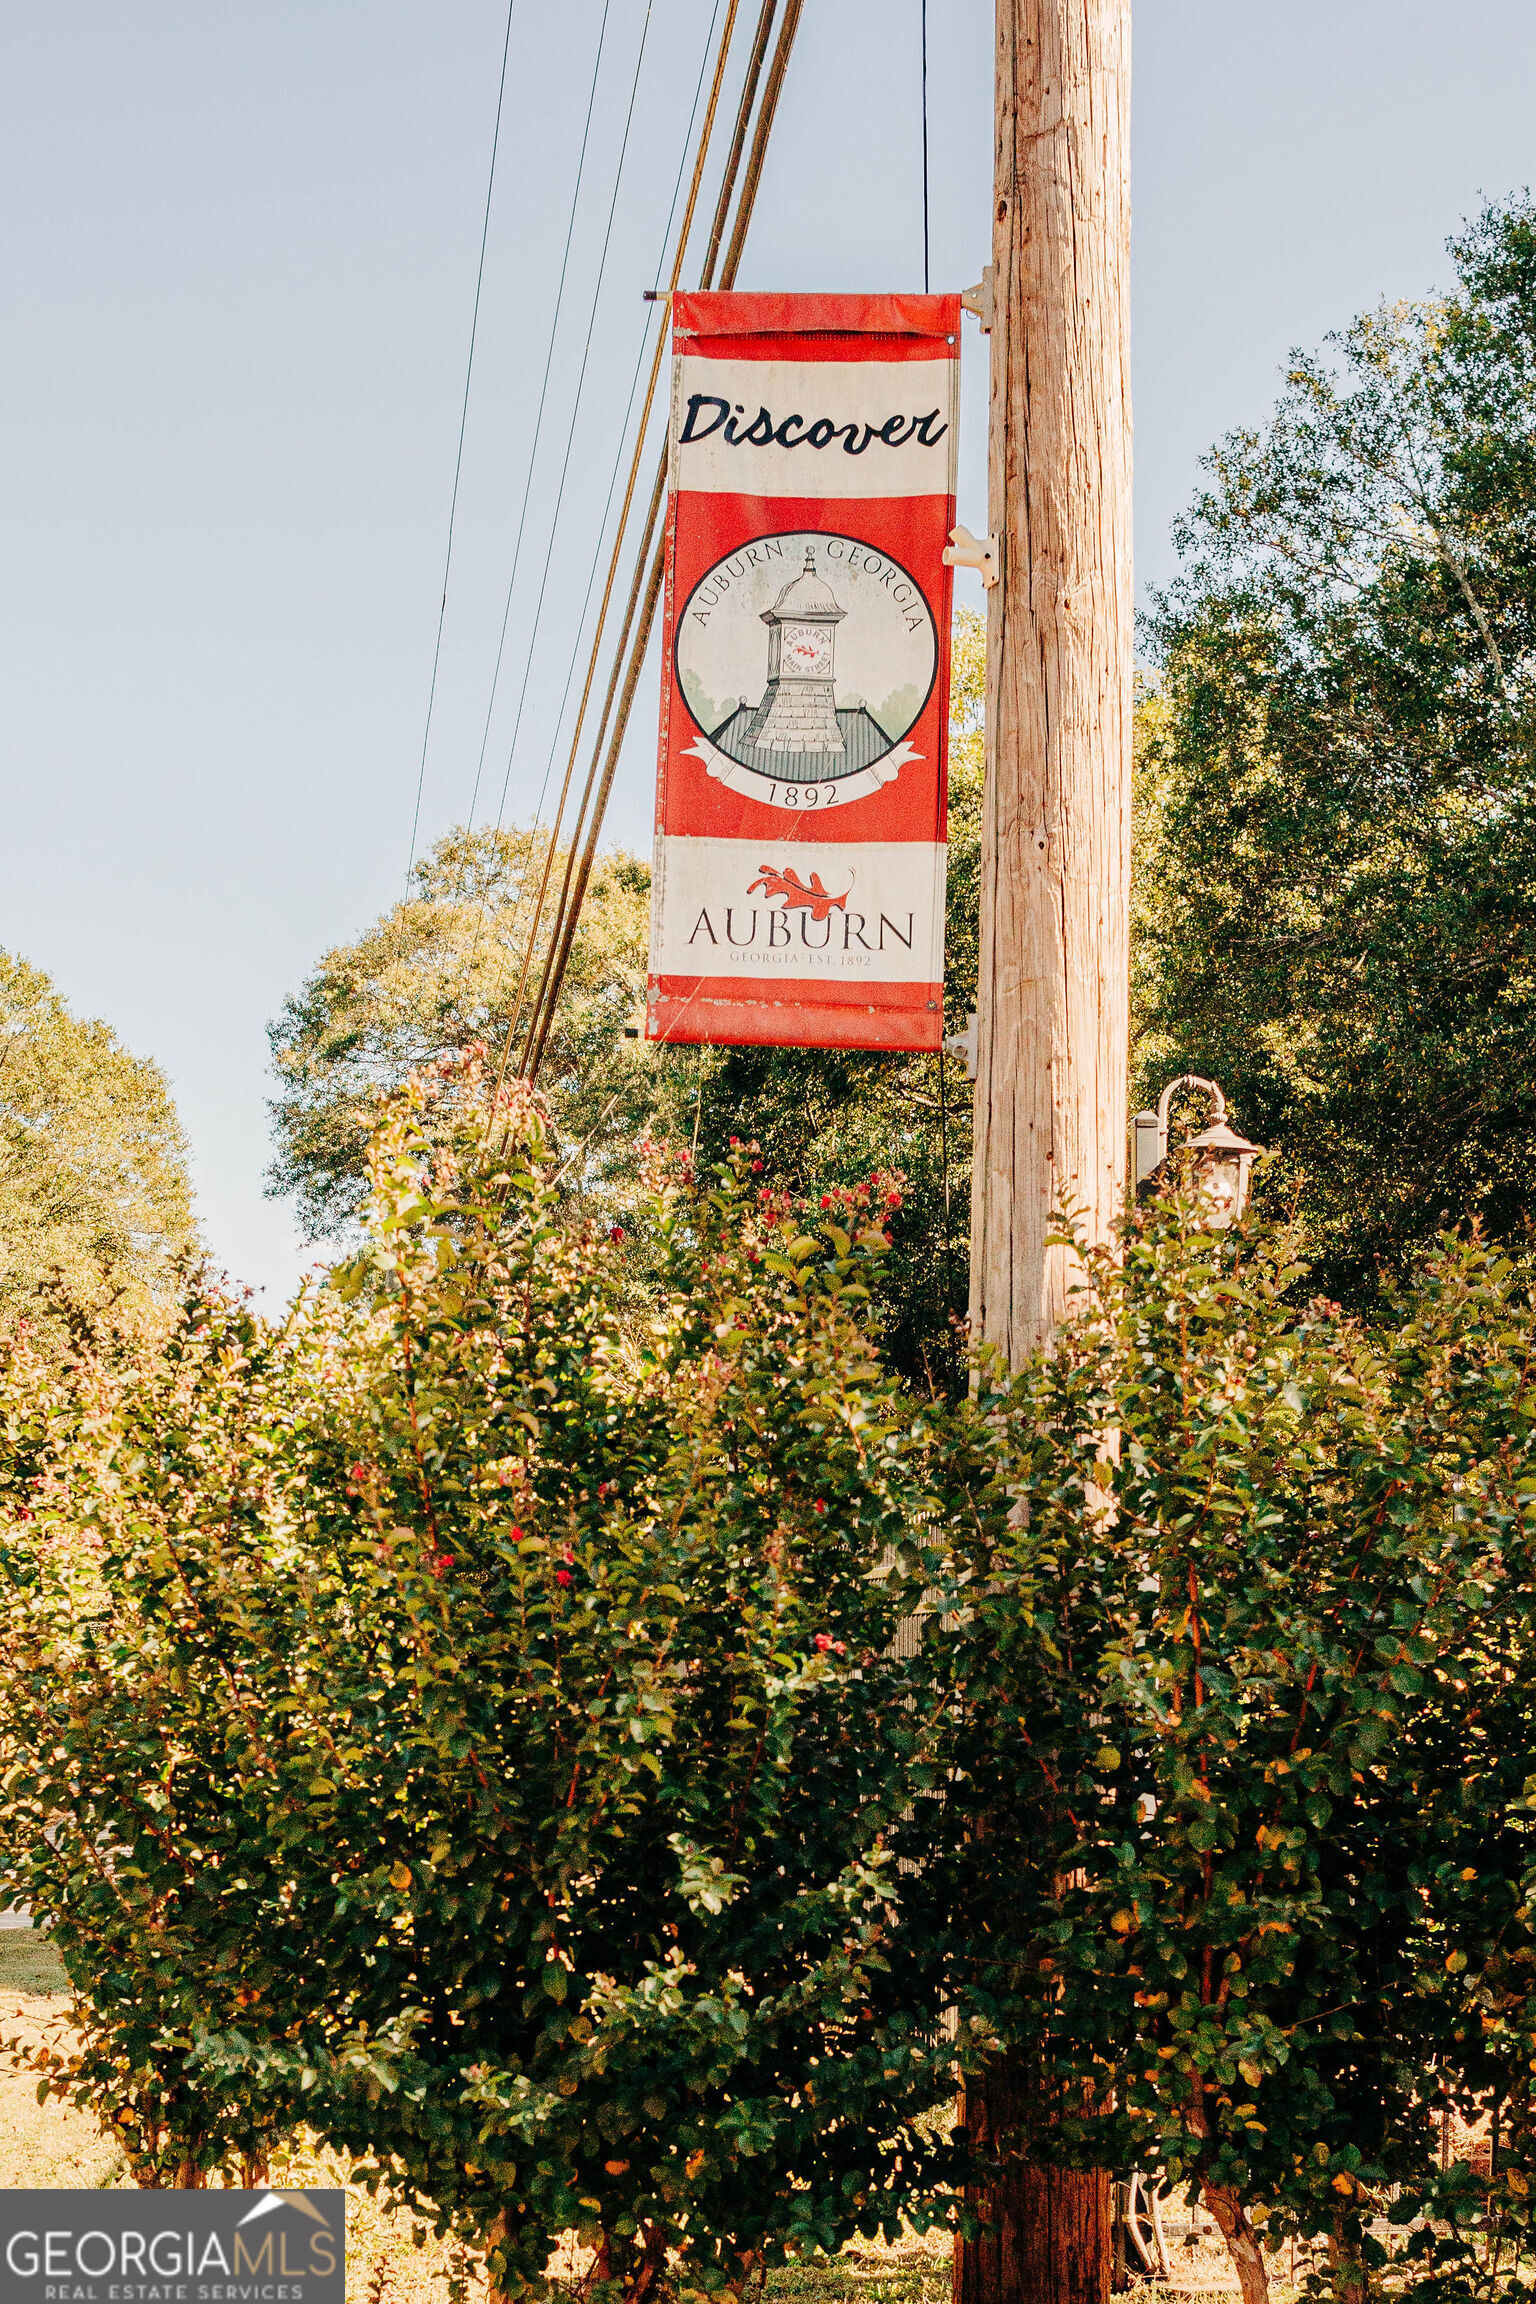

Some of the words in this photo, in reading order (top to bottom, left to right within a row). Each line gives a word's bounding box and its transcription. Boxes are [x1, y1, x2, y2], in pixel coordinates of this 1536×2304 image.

[678, 393, 949, 455] Discover
[691, 540, 784, 627] AUBURN
[826, 540, 924, 632] GEORGIA
[786, 629, 827, 647] AUBURN
[786, 654, 803, 671] MAIN
[804, 652, 830, 672] STREET
[766, 783, 840, 808] 1892
[684, 907, 915, 951] AUBURN
[840, 955, 872, 966] 1892
